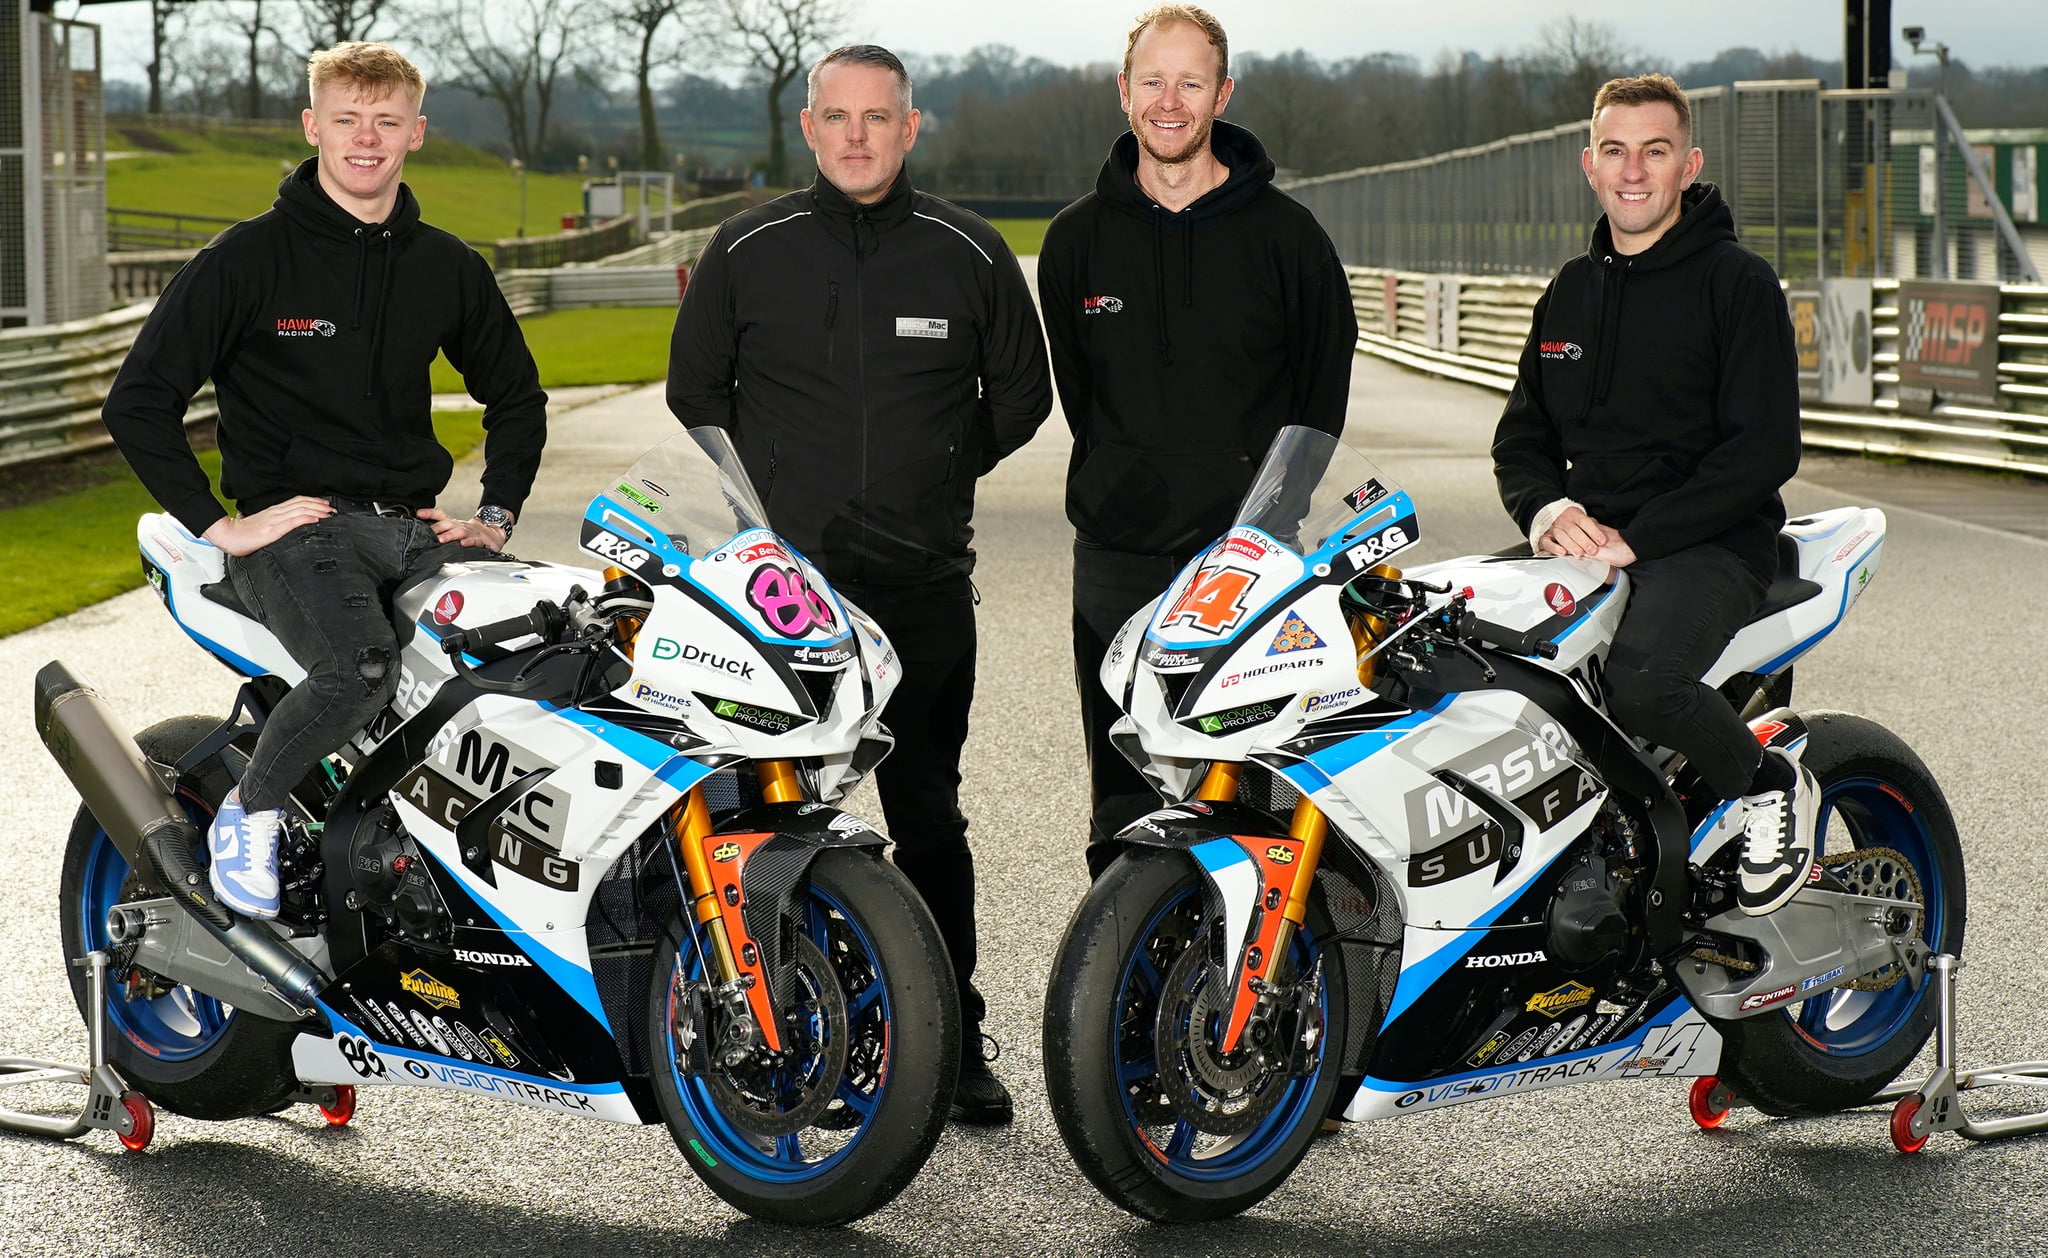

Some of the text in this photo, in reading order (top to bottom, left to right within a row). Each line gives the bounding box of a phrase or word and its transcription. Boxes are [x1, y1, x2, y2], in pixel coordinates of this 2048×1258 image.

[928, 321, 946, 330] Mac
[586, 531, 650, 570] R&G
[1226, 541, 1262, 559] ennetts
[1346, 526, 1409, 571] R&G
[1161, 565, 1260, 635] 14
[682, 644, 756, 680] Druck
[1243, 658, 1324, 680] HOCOPARTS
[636, 684, 693, 708] Paynes
[1304, 686, 1361, 713] Paynes
[1320, 700, 1349, 711] Hinckley
[734, 712, 789, 732] PROJECTS
[737, 705, 791, 724] KOVARA
[1218, 703, 1273, 722] KOVARA
[1222, 709, 1277, 729] PROJECTS
[713, 843, 740, 861] sbs
[1267, 845, 1294, 862] sbs
[357, 855, 380, 874] R&G
[453, 948, 533, 967] HONDA
[1465, 950, 1548, 968] HONDA
[400, 971, 460, 1001] Putoline
[1525, 987, 1596, 1012] Putoline
[366, 998, 403, 1038] SPIDER
[1621, 1022, 1707, 1078] 14
[428, 1064, 597, 1113] VISIONTRACK
[1427, 1056, 1604, 1103] VISIONTRACK
